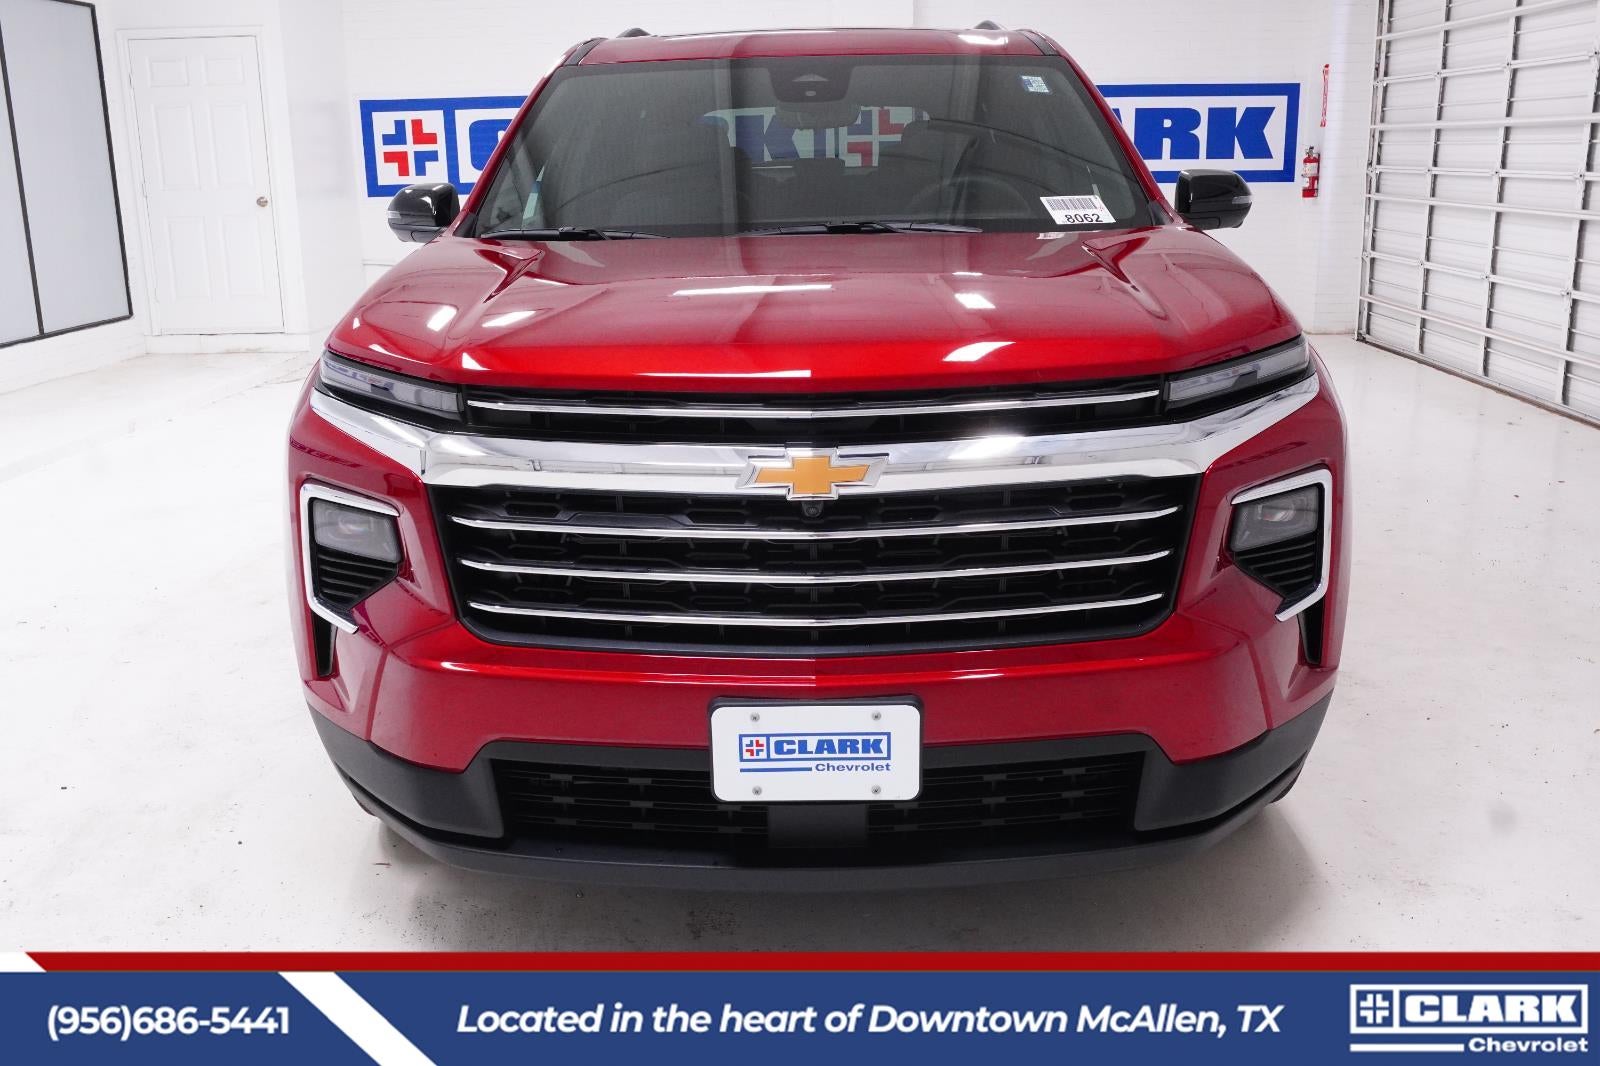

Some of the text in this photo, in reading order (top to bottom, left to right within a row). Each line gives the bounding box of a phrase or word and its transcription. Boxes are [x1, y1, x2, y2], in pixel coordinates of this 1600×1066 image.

[1112, 106, 1275, 161] RK
[1064, 213, 1104, 223] 8062
[774, 738, 883, 755] CLARK
[814, 762, 891, 772] Chevrolet
